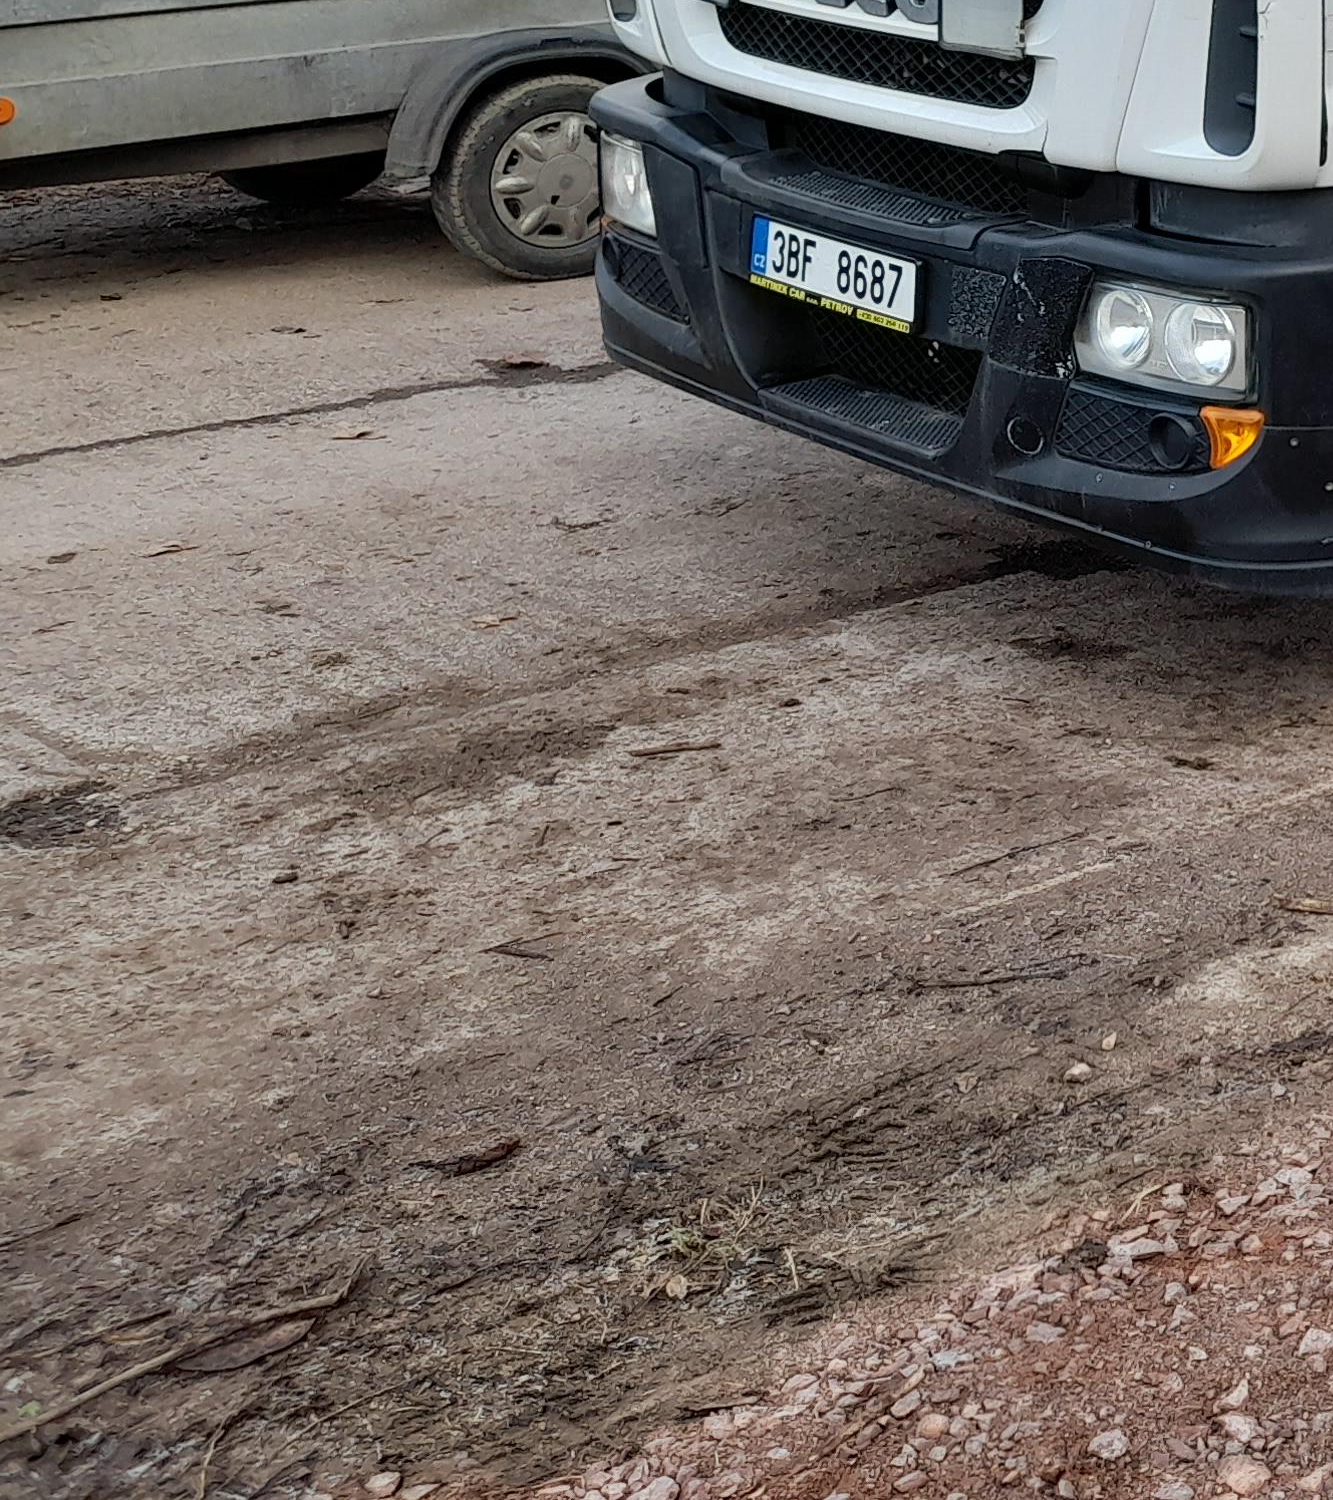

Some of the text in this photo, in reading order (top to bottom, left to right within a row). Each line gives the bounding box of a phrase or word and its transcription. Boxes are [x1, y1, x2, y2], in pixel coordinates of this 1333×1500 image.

[754, 230, 904, 309] CZ 3BF 8687
[789, 287, 805, 301] CAR
[820, 297, 854, 316] PETROV
